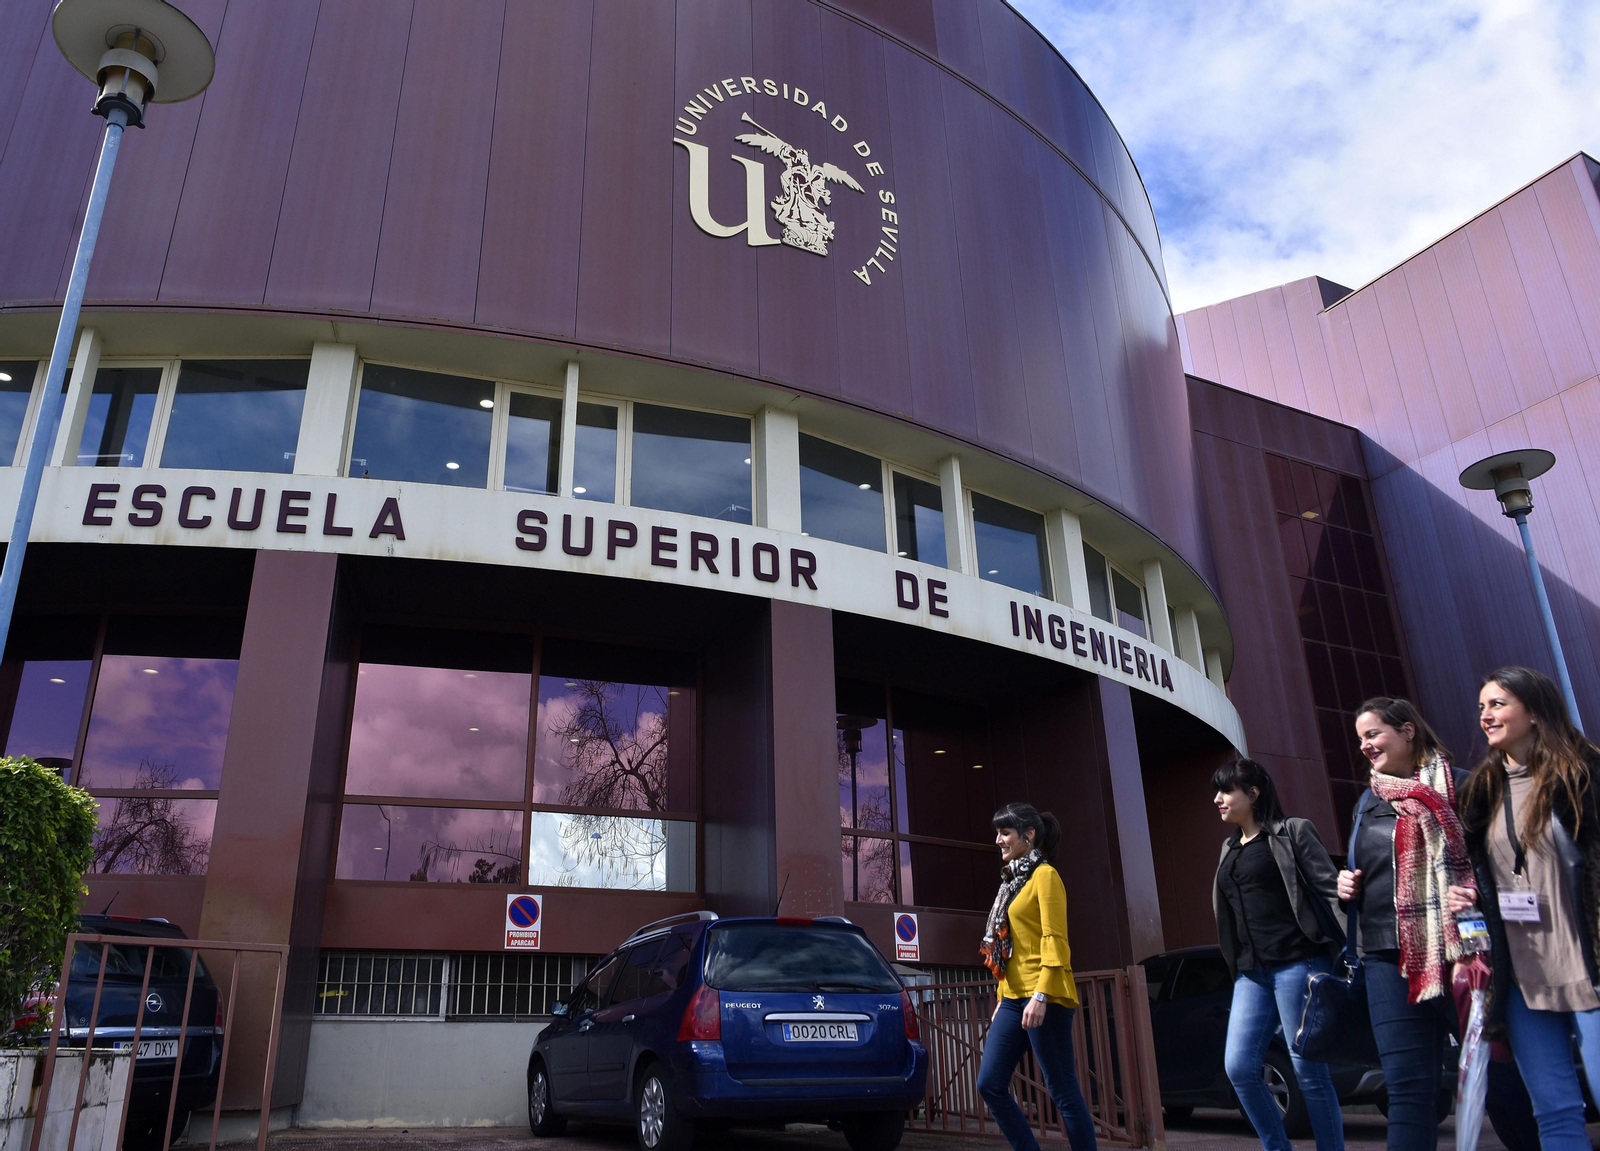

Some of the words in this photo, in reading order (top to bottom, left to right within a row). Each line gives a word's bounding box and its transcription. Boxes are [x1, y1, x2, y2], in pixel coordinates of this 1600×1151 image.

[675, 76, 849, 137] UNIVERSIDAD
[853, 140, 885, 178] DE
[852, 188, 900, 286] SEVILLA
[82, 483, 406, 541] ESCUELA
[515, 509, 818, 590] SUPERIOR
[895, 569, 949, 619] DE
[1010, 600, 1174, 692] INGENIERIA
[154, 1042, 174, 1056] DXY
[791, 1025, 827, 1039] 0020
[828, 1025, 854, 1039] CRL
